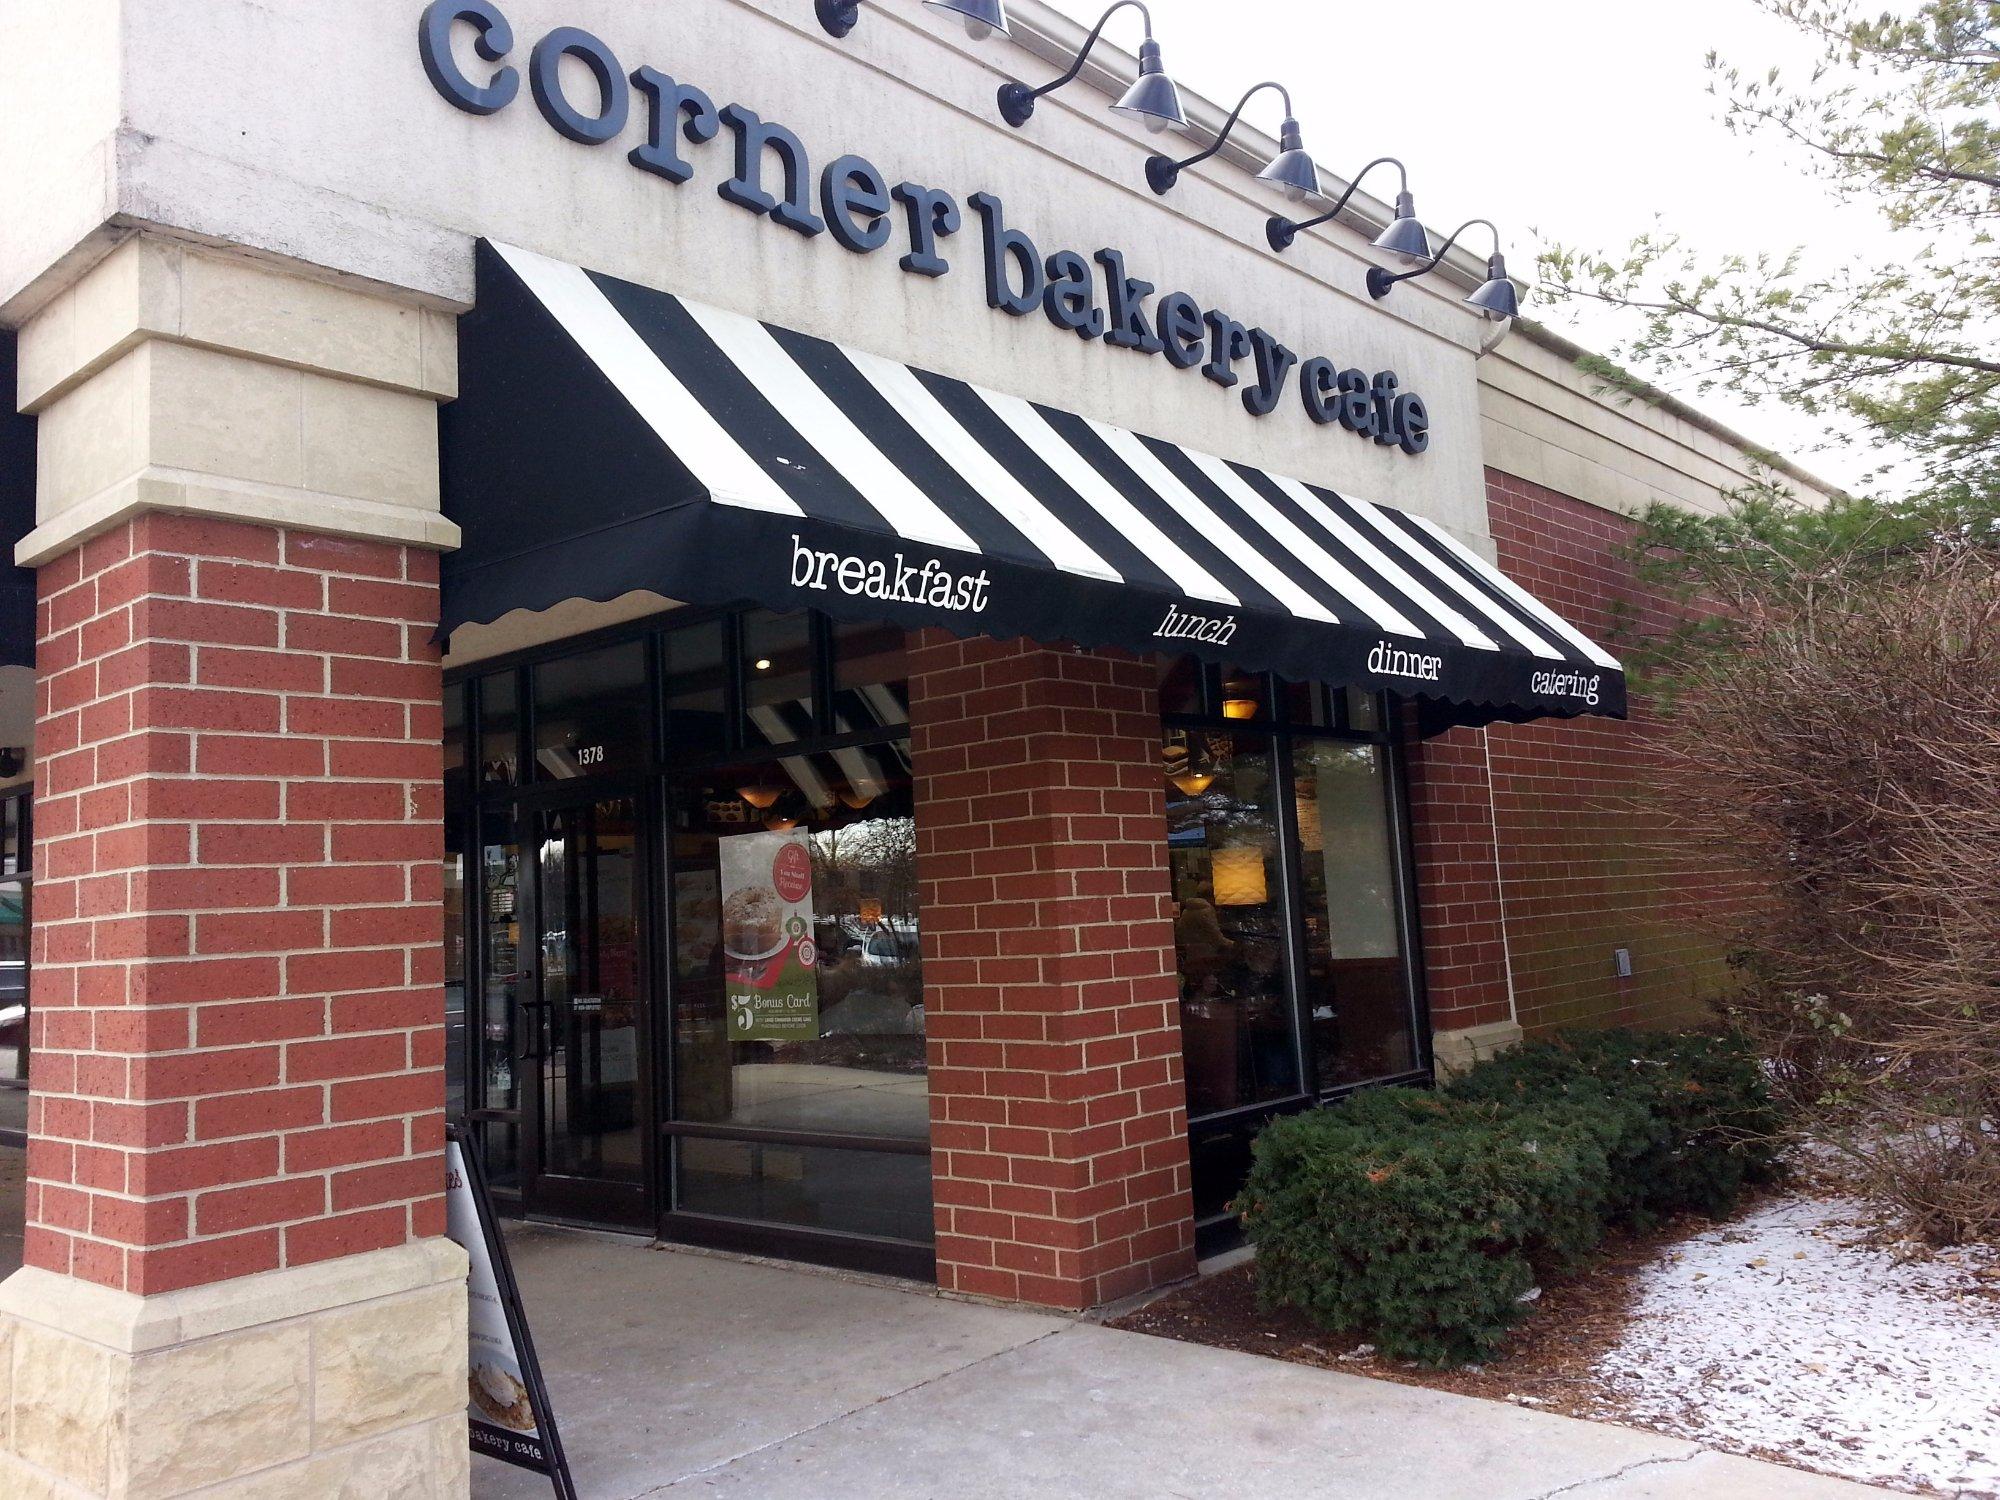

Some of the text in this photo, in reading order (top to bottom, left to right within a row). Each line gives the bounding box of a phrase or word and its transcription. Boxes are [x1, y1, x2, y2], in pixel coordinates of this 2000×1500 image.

[418, 0, 1429, 456] corner bakery cafe
[790, 534, 1600, 706] breakfast lunch dinner catering
[577, 745, 604, 766] 1378
[754, 993, 784, 1009] Bonus
[786, 992, 812, 1008] Card
